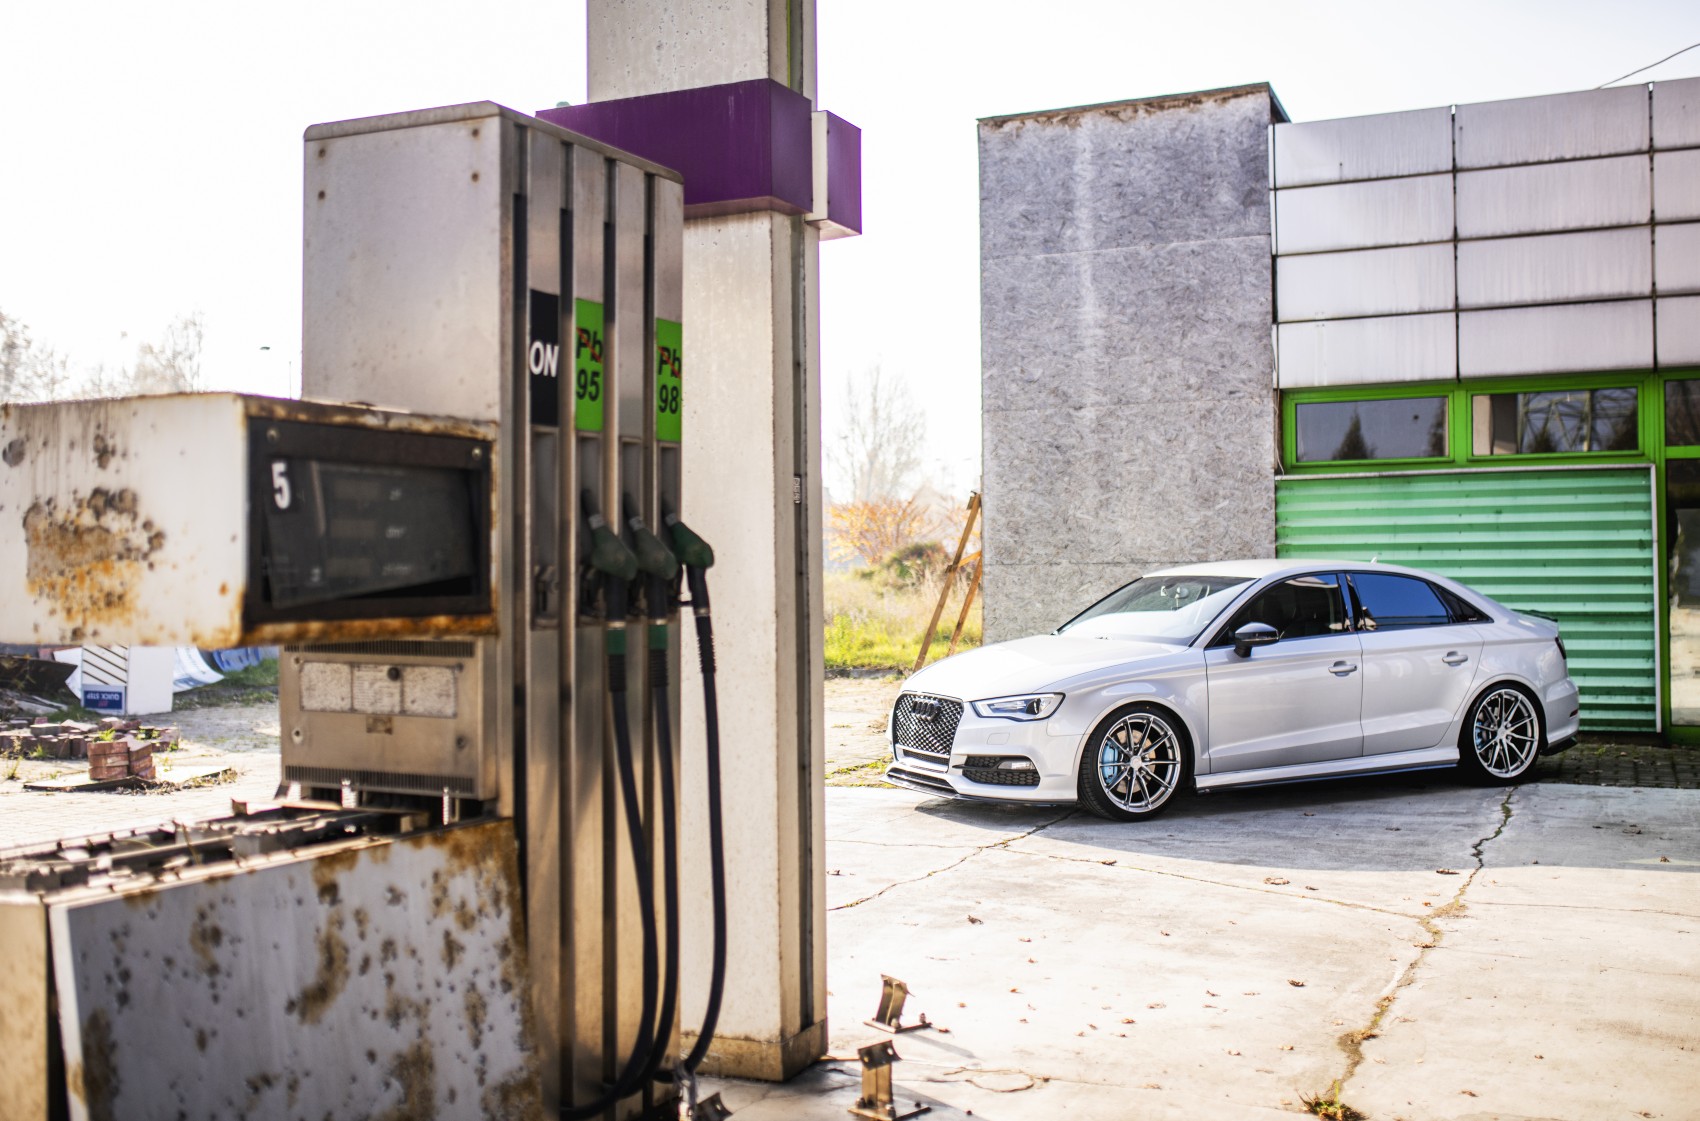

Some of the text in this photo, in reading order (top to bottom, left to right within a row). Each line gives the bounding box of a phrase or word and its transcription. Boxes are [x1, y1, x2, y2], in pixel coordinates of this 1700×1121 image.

[529, 341, 558, 377] ON
[576, 327, 604, 364] Pb
[658, 346, 682, 379] Pb
[576, 368, 601, 402] 95
[658, 384, 680, 415] 98
[271, 461, 291, 509] 5
[101, 692, 119, 700] QUICK
